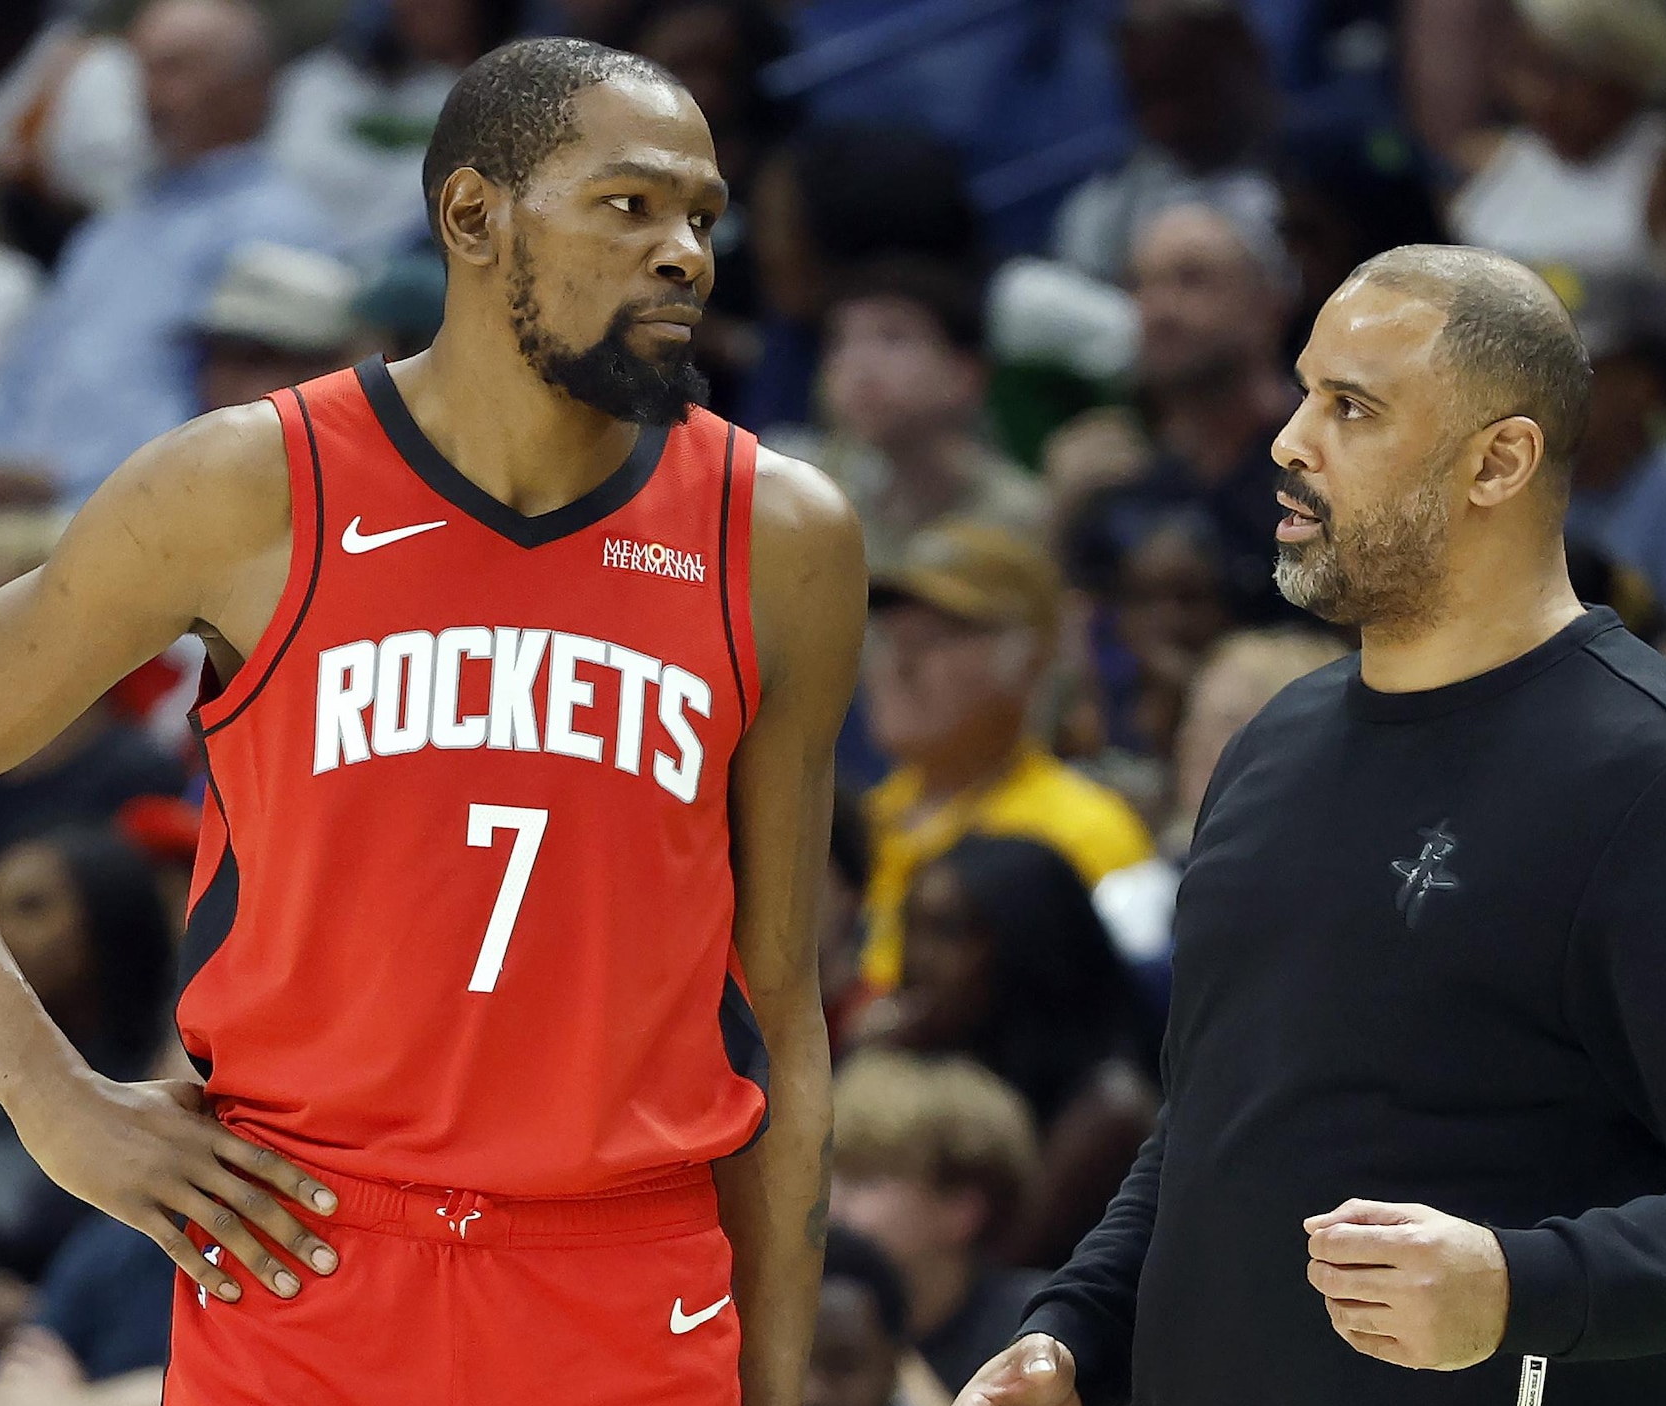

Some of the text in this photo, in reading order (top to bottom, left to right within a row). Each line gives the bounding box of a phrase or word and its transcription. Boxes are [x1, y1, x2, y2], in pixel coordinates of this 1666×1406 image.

[602, 550, 706, 582] HERMANN
[603, 538, 706, 570] MEMORIAL
[312, 625, 712, 805] ROCKETS
[466, 803, 549, 994] 7
